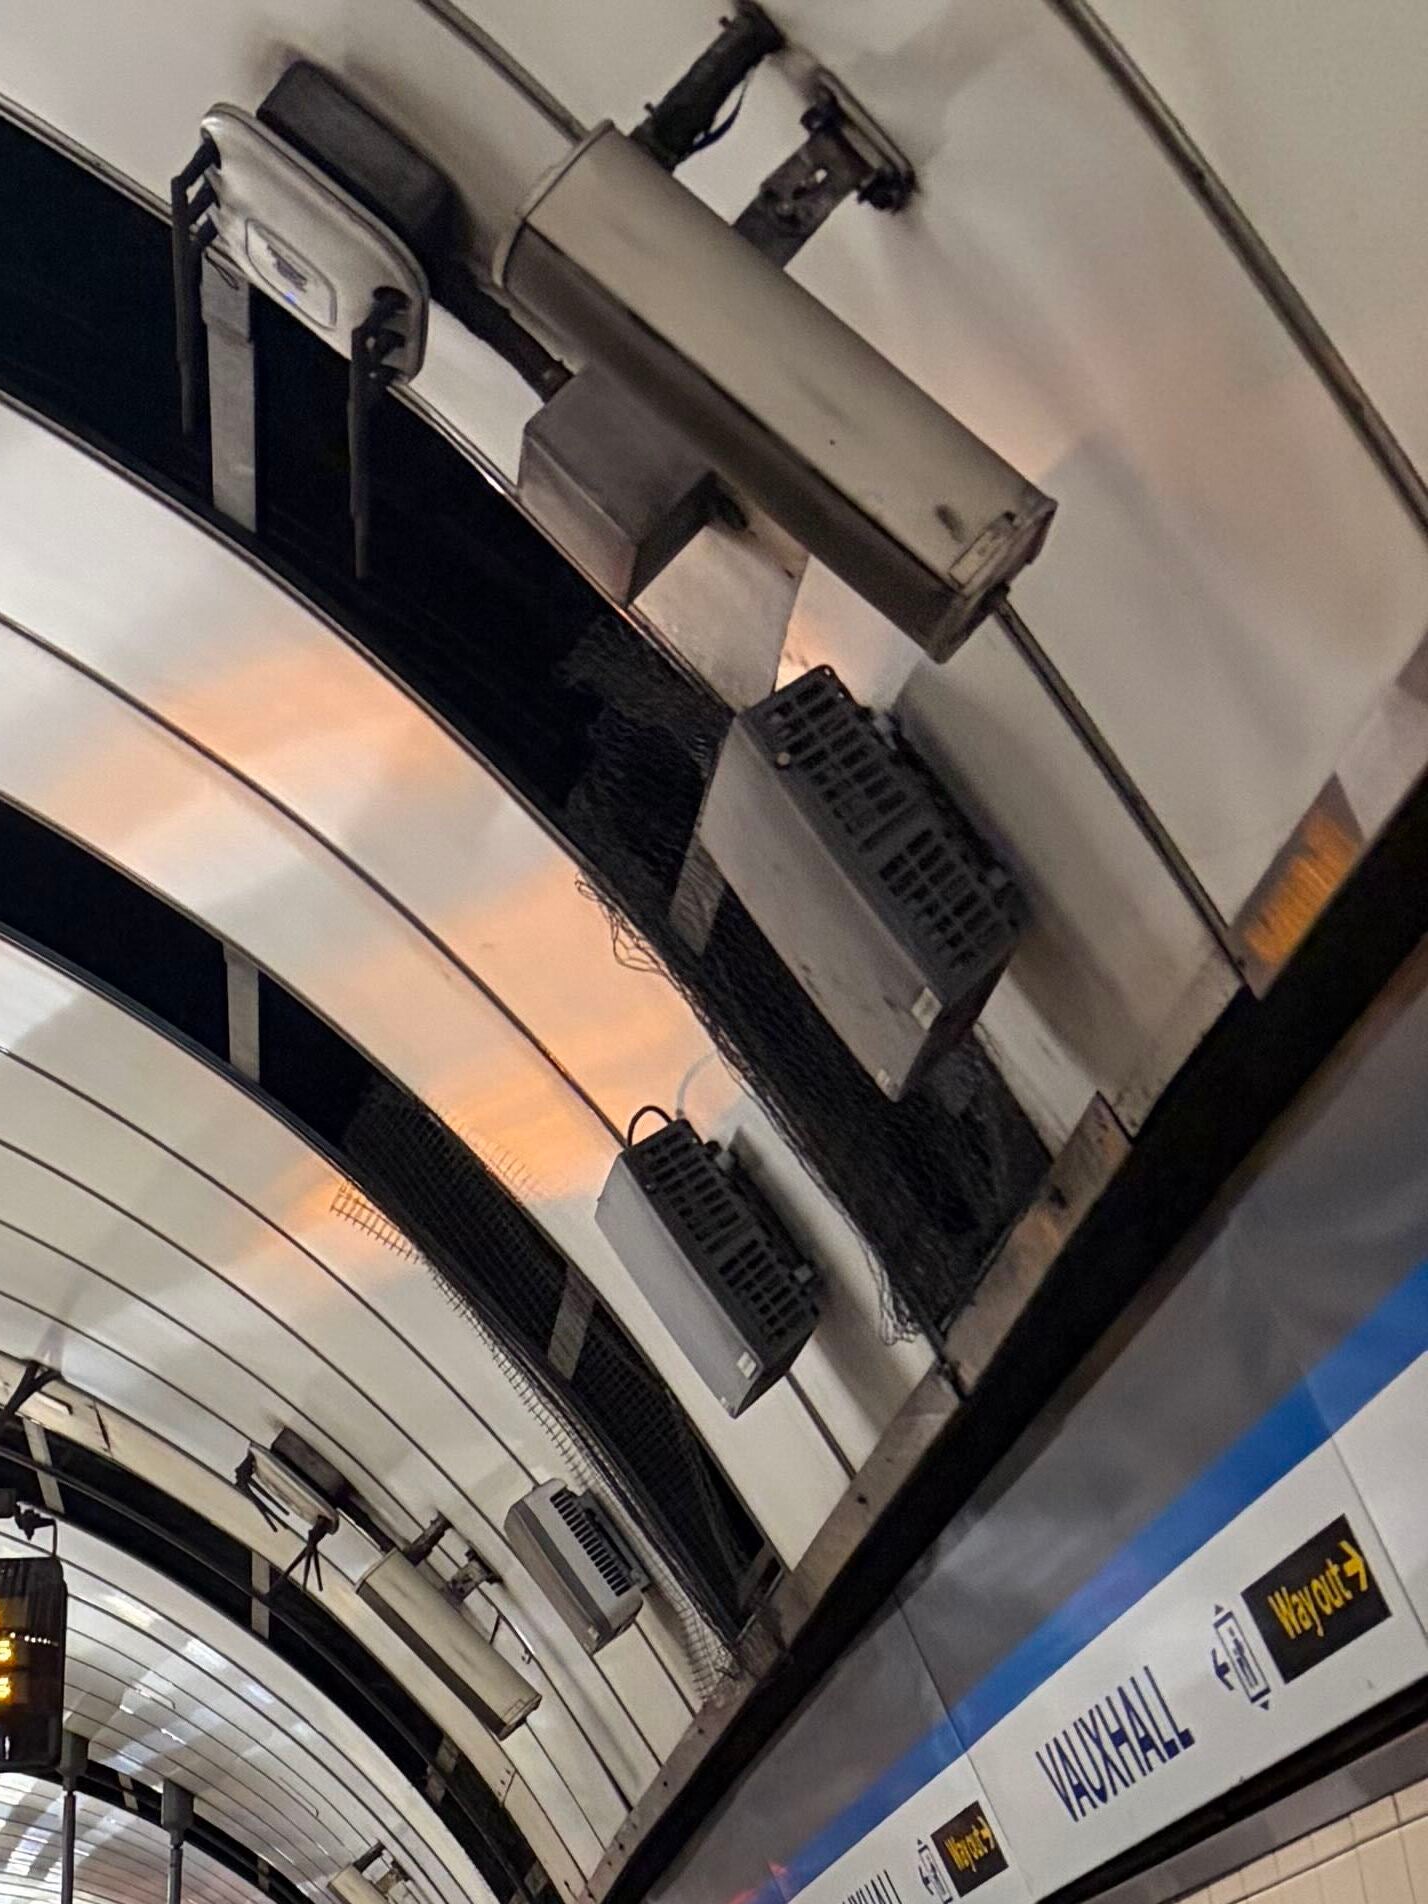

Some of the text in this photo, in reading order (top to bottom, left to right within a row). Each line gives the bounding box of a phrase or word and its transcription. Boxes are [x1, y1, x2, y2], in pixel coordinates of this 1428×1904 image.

[1035, 1558, 1353, 1822] VAUXHALL Way out
